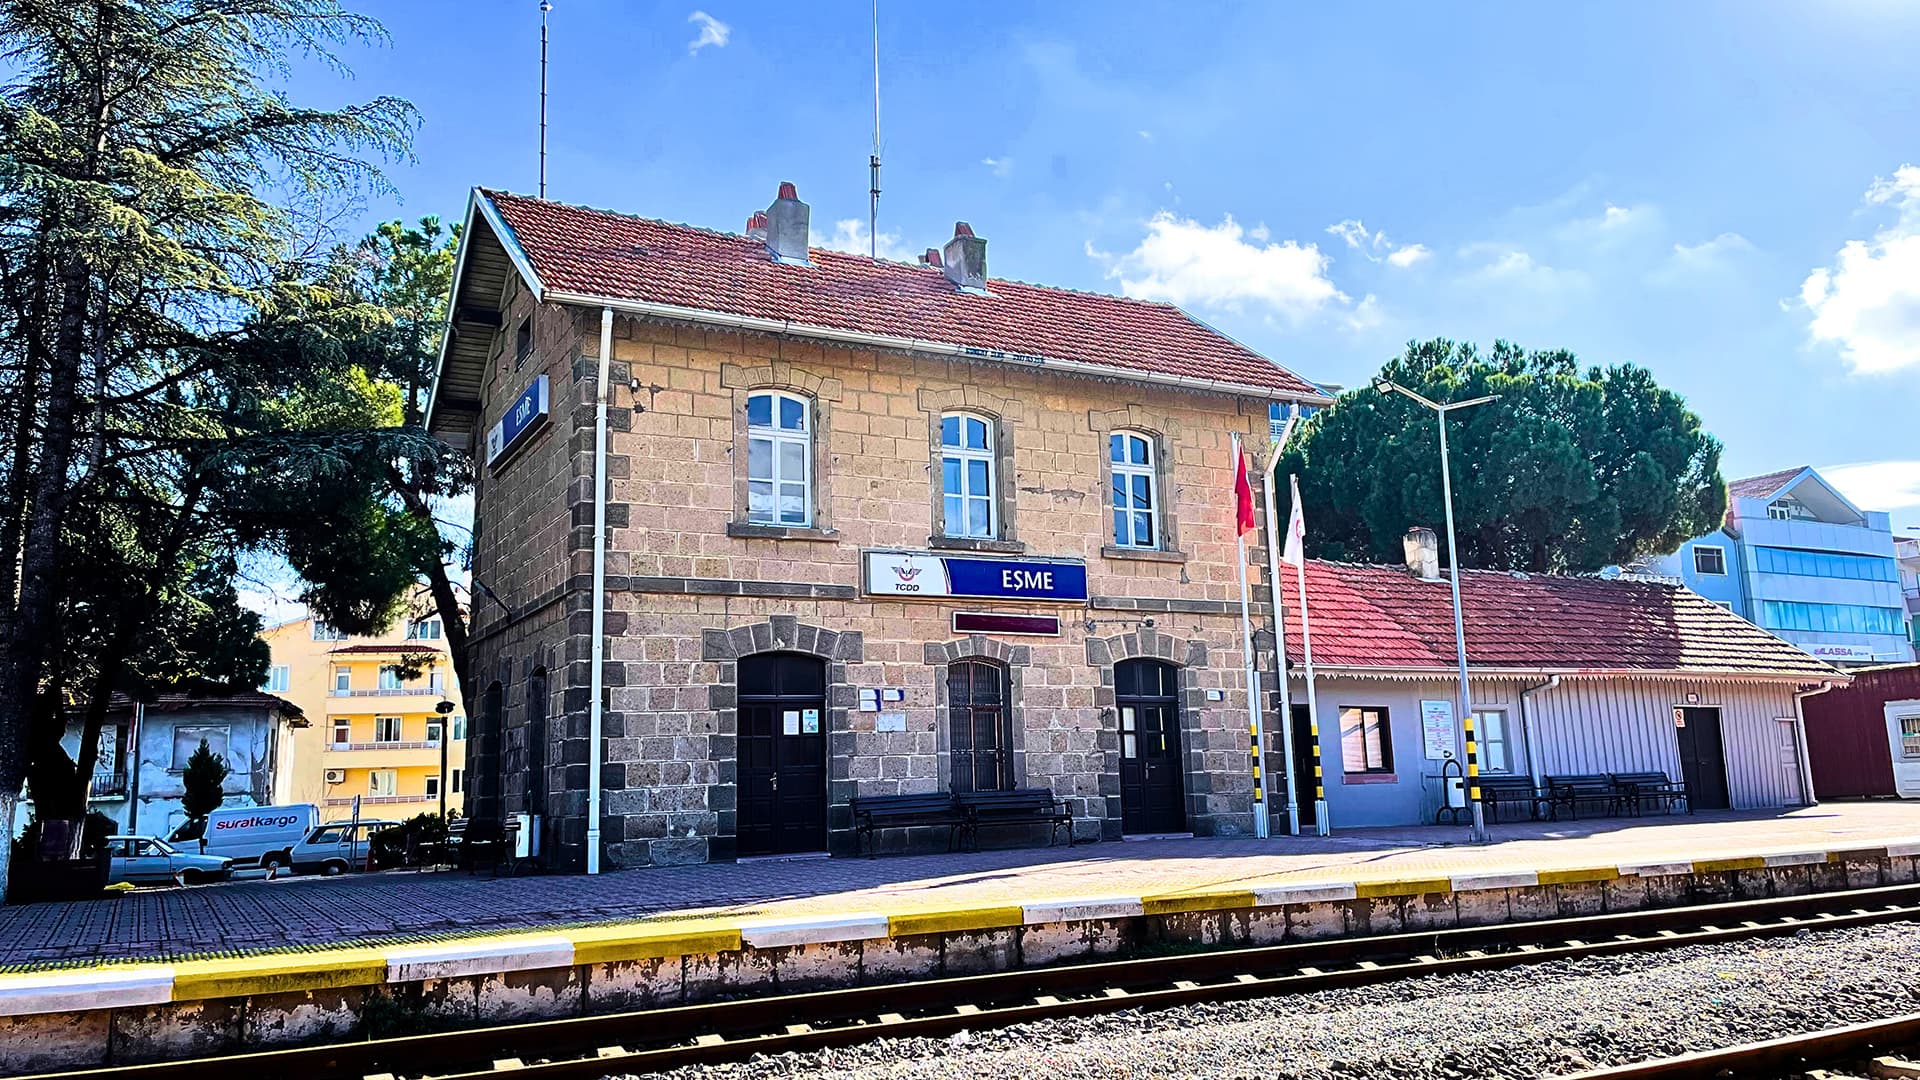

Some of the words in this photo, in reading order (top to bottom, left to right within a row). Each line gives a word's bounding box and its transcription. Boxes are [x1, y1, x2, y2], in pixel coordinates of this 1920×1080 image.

[895, 583, 920, 592] TCDD
[1002, 569, 1054, 591] EŞME
[216, 815, 298, 830] suratkargo
